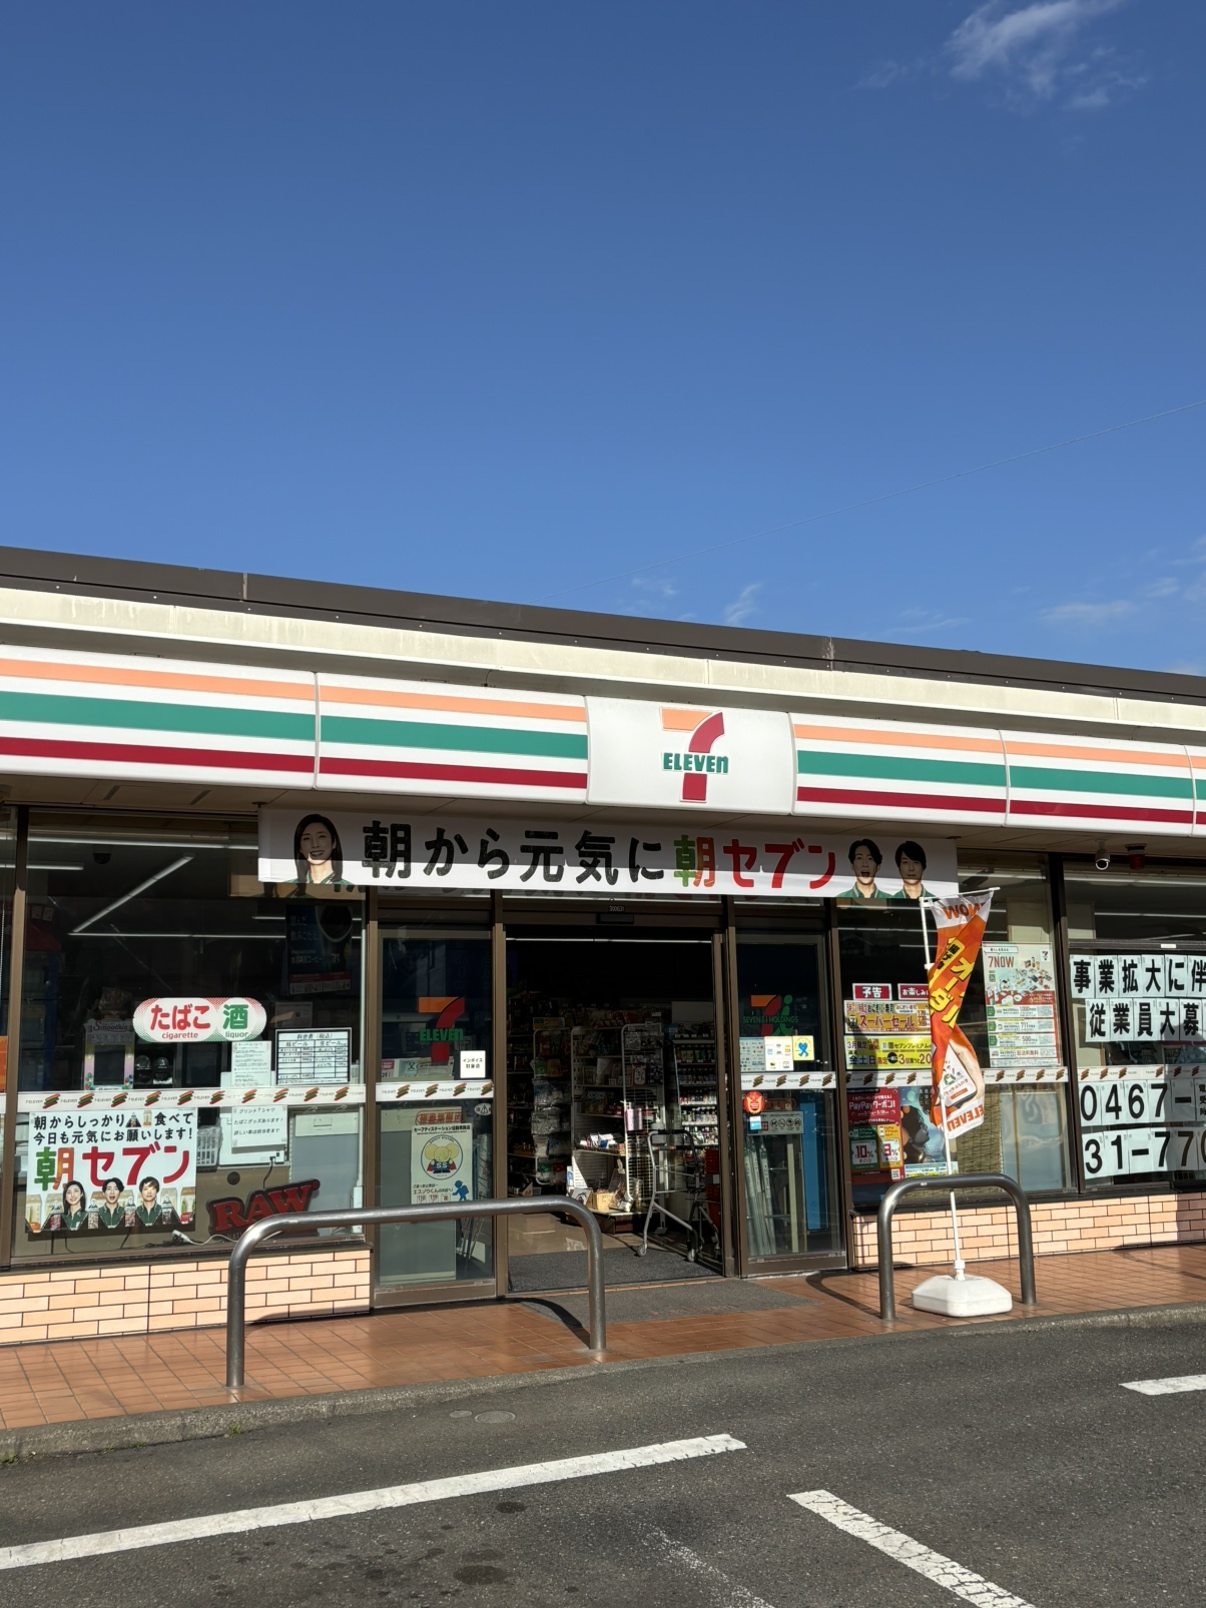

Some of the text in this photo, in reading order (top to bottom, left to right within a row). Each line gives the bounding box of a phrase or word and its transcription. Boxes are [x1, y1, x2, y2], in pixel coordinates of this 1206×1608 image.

[661, 708, 725, 801] 7
[361, 820, 836, 889] 朝から元気に朝セブン
[988, 955, 1015, 968] 7NOW
[862, 986, 882, 998] 予告
[150, 1003, 249, 1030] たばこ 酒
[769, 1015, 799, 1023] HOLDINGS
[161, 1031, 249, 1040] cigarette liquor
[33, 1112, 193, 1130] 朝からしっかり 食べて
[33, 1127, 193, 1146] 今日も元気にお願いします!
[34, 1141, 190, 1191] 朝セブン
[213, 1184, 312, 1232] RAW
